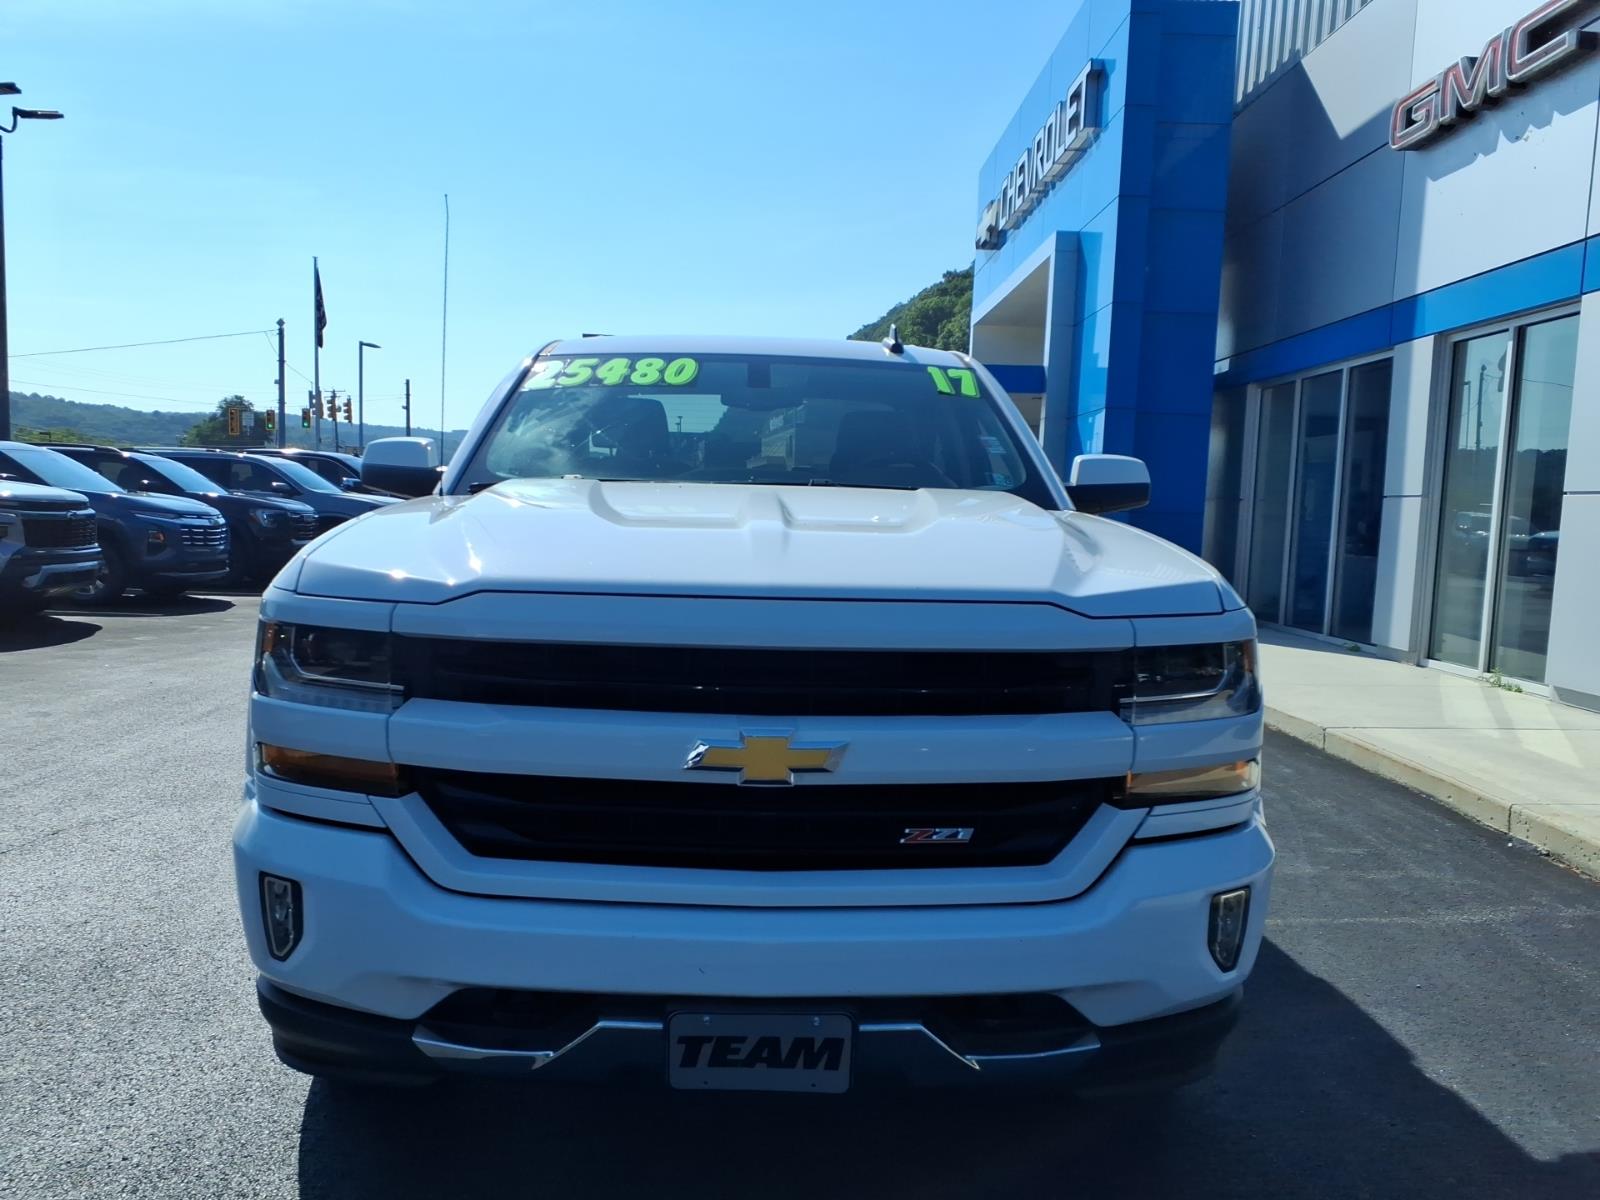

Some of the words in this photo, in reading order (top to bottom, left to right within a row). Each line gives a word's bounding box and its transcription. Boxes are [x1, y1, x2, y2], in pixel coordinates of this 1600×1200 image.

[1389, 0, 1584, 149] GMC
[999, 58, 1096, 231] CHEVROLET
[523, 357, 698, 391] 25480
[927, 366, 980, 398] 17
[677, 1036, 845, 1070] TEAM
